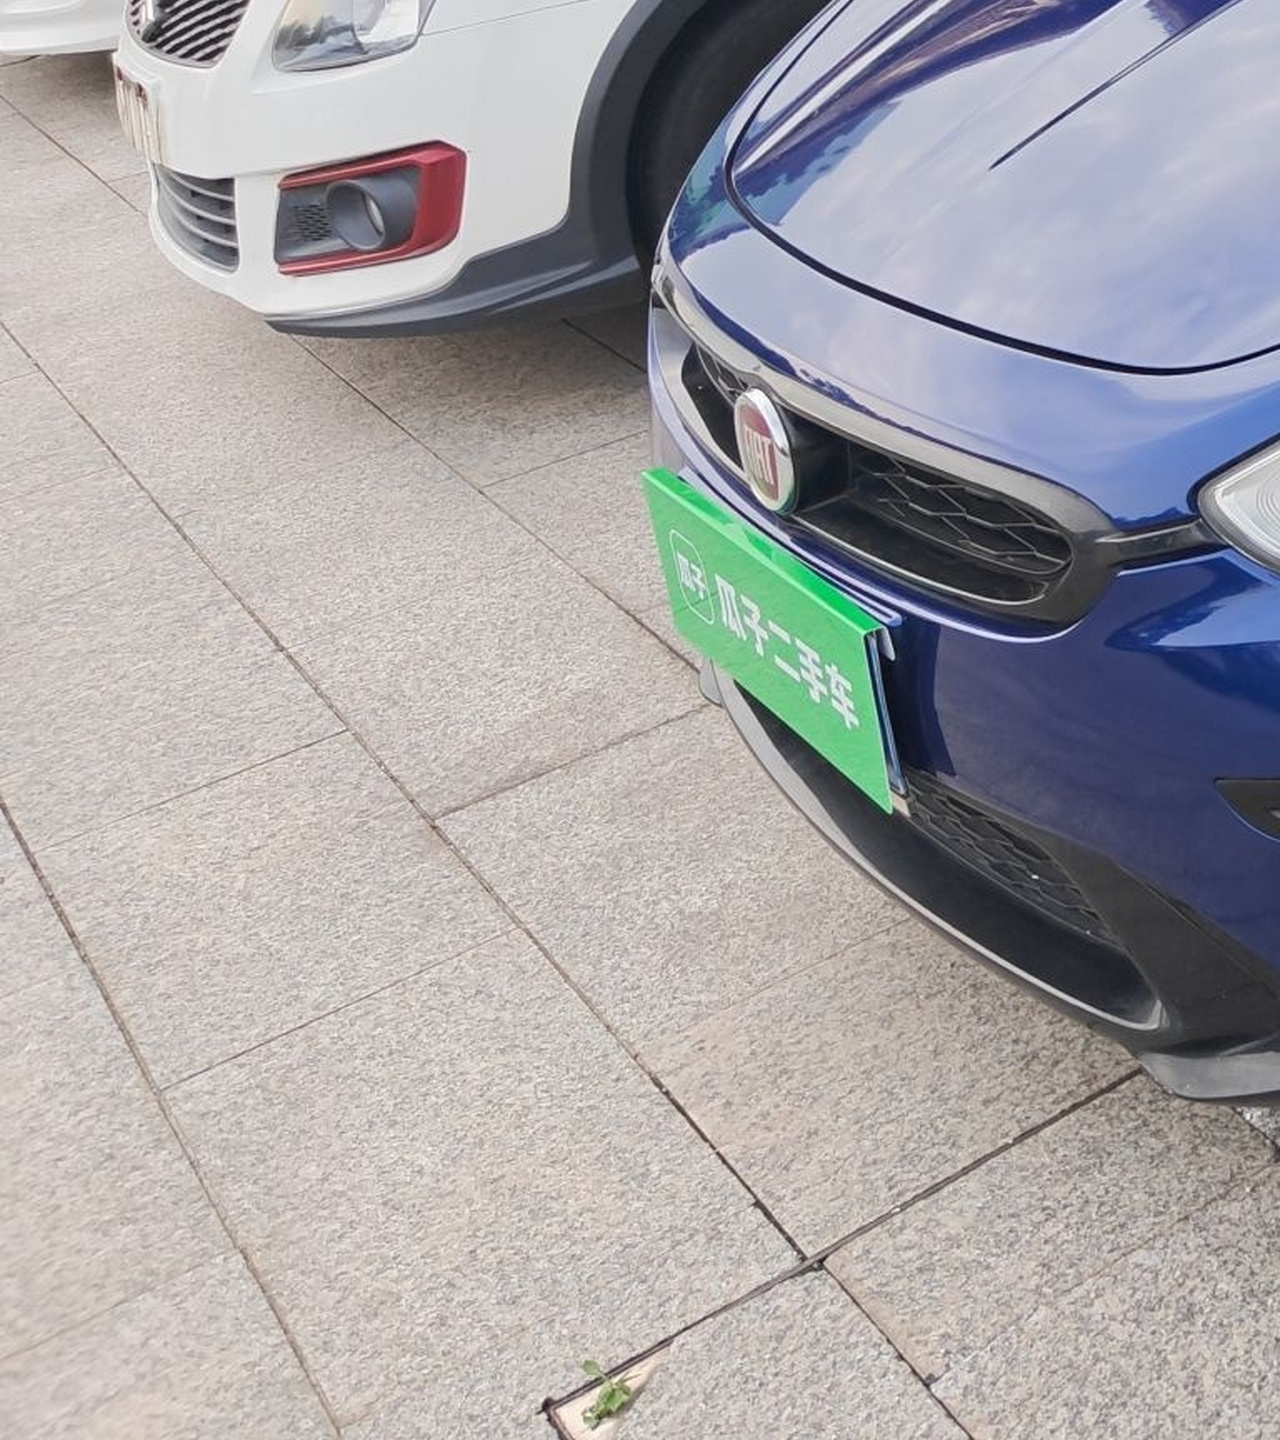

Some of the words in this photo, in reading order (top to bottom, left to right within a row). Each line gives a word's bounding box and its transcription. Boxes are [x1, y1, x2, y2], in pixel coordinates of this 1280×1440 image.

[743, 423, 775, 487] FIAT
[676, 551, 707, 601] 瓜子
[714, 572, 860, 730] 瓜子二手车
